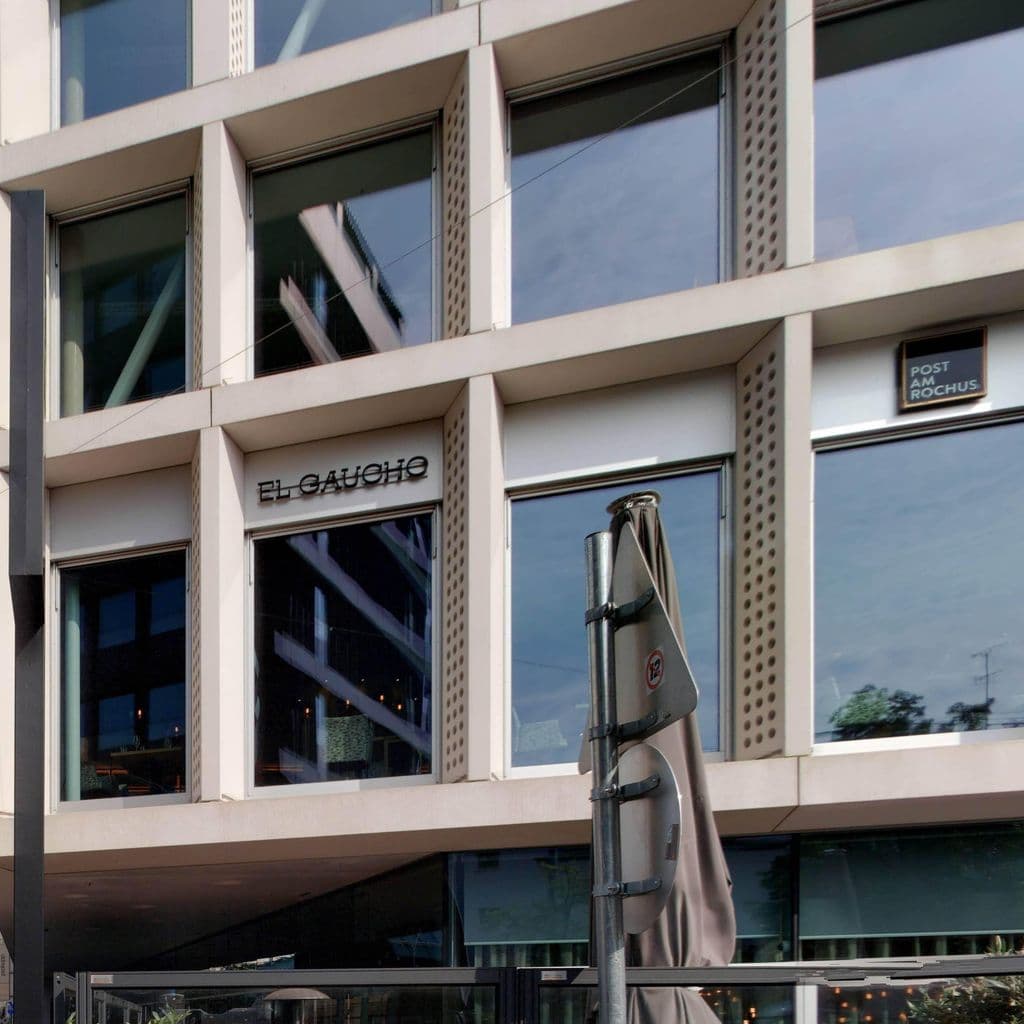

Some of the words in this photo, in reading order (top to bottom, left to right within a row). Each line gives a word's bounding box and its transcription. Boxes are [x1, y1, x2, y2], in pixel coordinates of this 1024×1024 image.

[911, 361, 950, 377] POST
[910, 375, 935, 389] AM
[911, 379, 978, 400] ROCHUS
[257, 480, 291, 503] EL
[299, 455, 429, 495] GAUCHO
